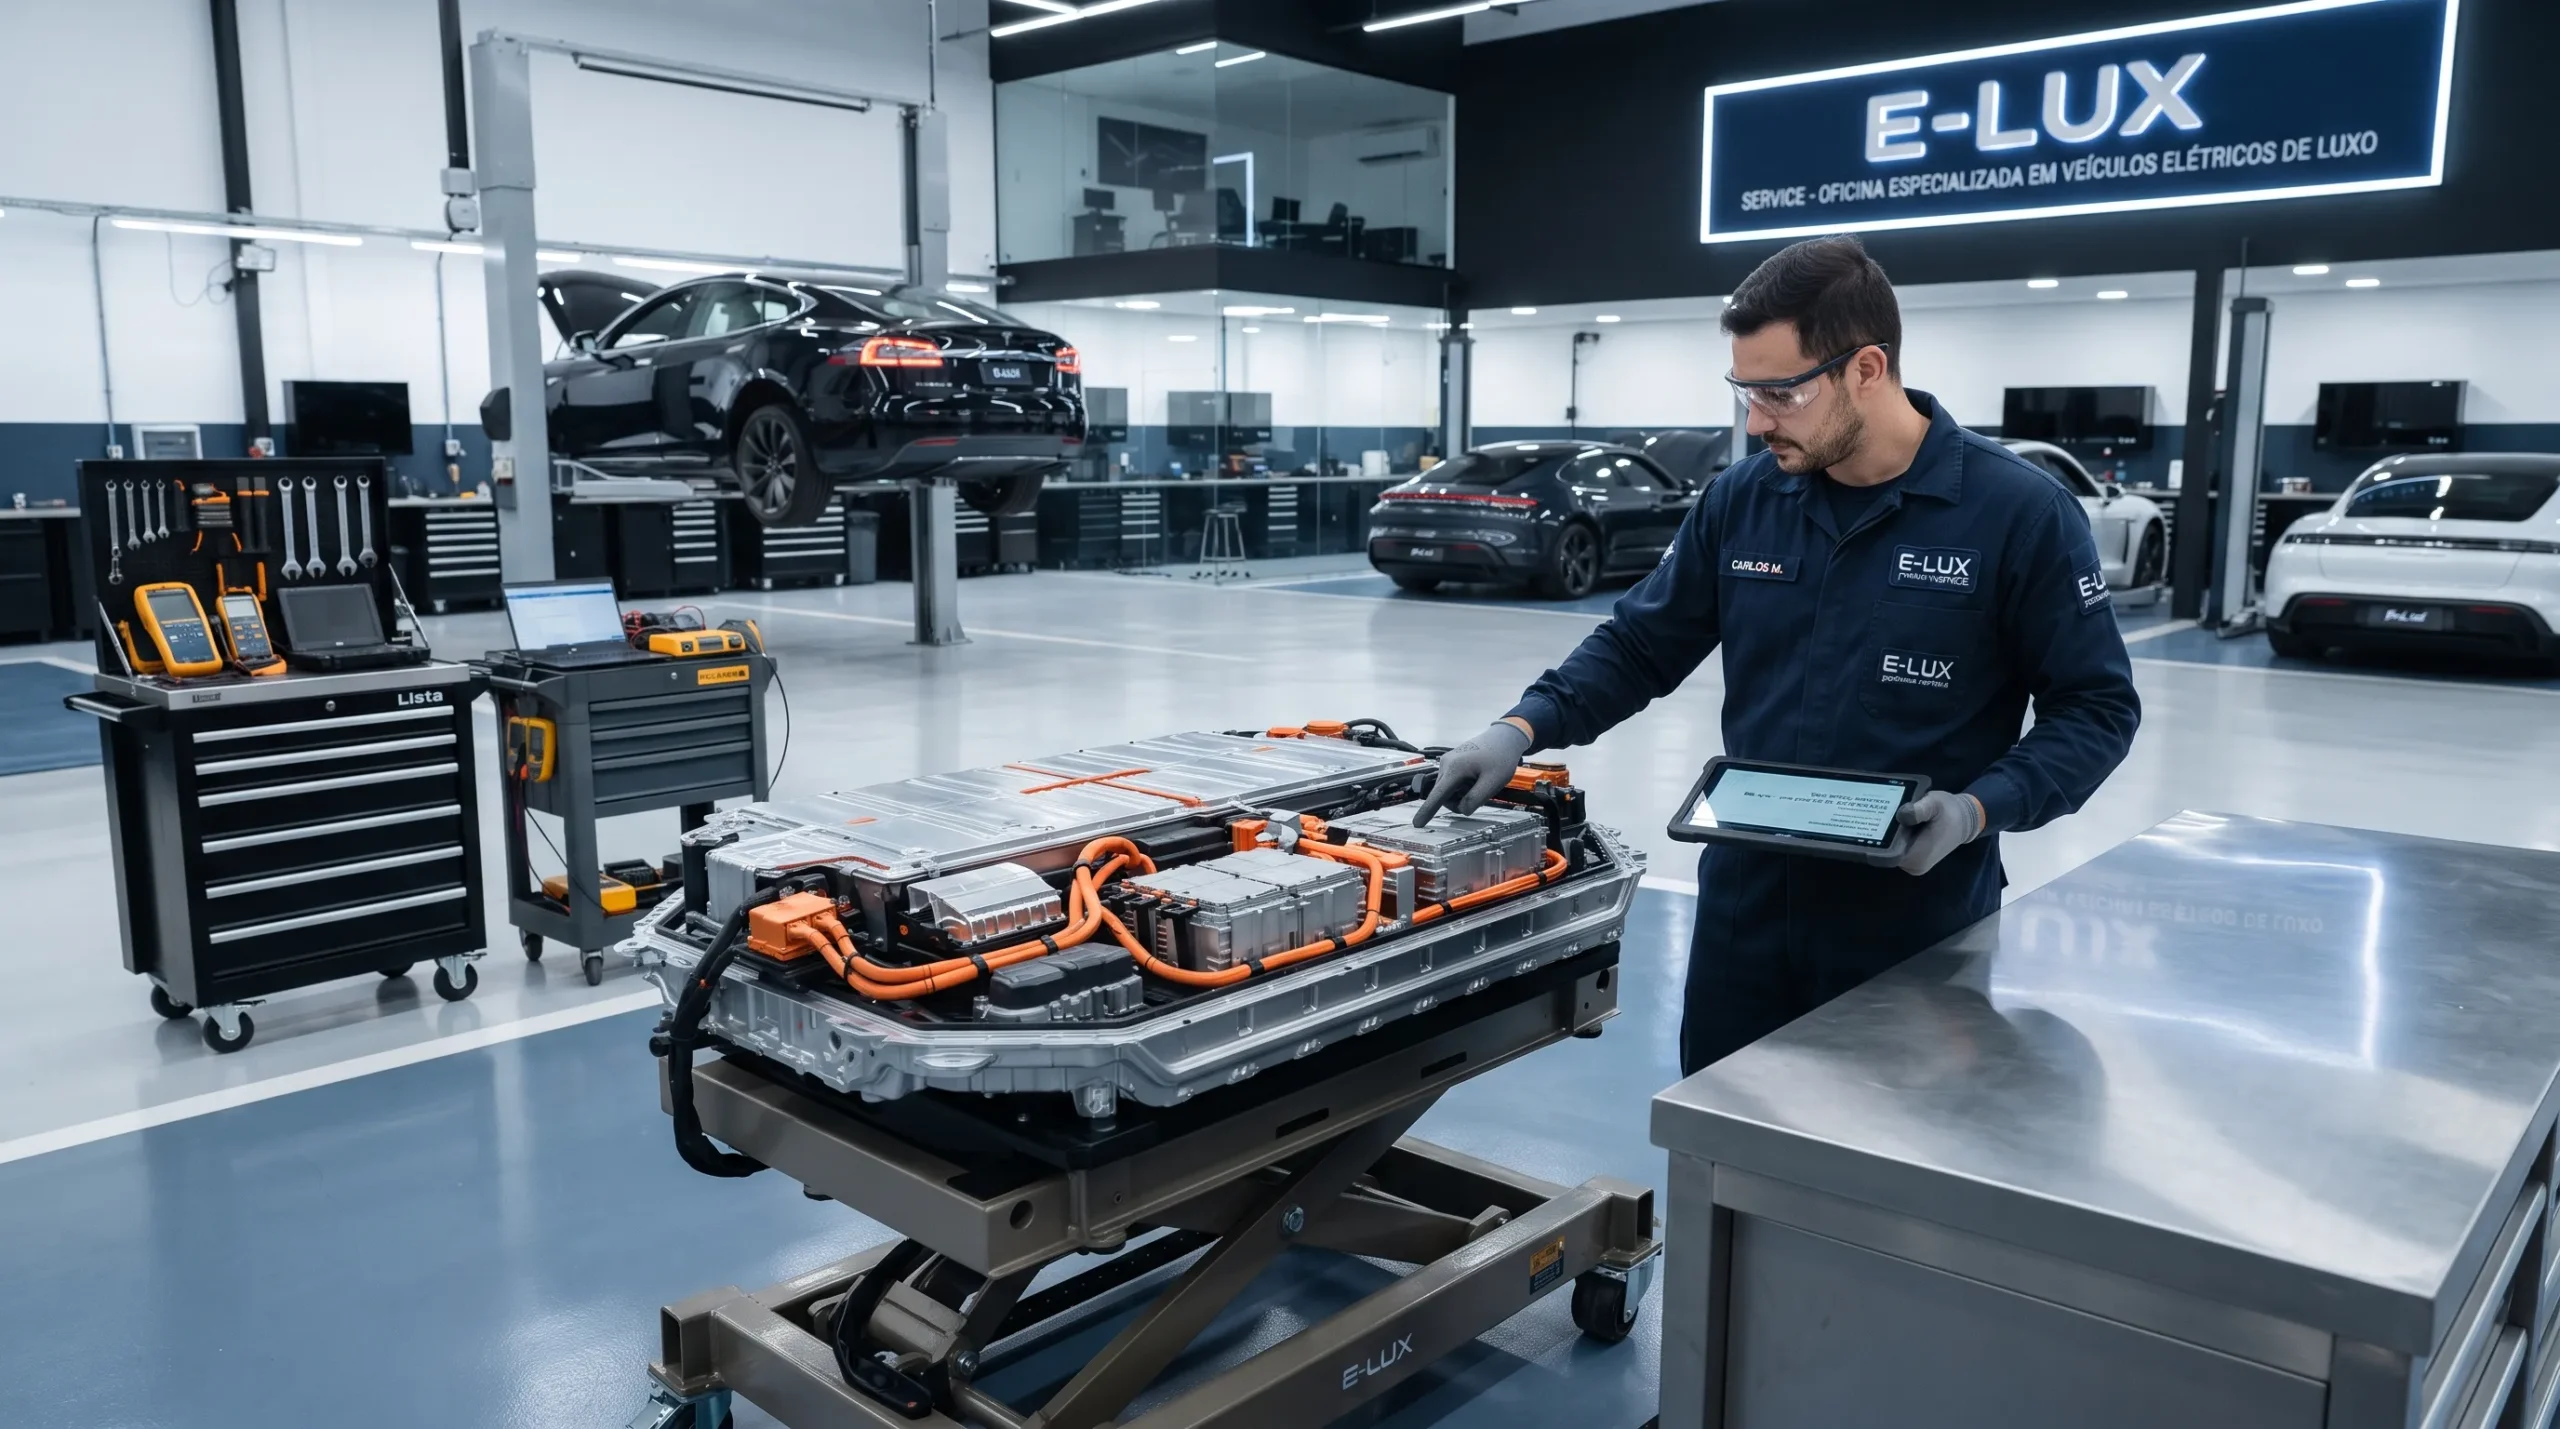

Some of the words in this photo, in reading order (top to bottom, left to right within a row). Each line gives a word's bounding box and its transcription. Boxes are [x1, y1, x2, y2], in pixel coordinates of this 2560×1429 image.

[1865, 53, 2206, 162] E-LUX
[1741, 186, 1806, 211] SERVICE
[1818, 179, 1885, 204] OFICINA
[1888, 167, 2024, 198] ESPECIALIZADA
[2028, 162, 2058, 185] EM
[2062, 152, 2158, 180] VEÍCULOS
[2162, 142, 2278, 174] ELÉTRICOS
[2281, 137, 2313, 162] DE
[2316, 130, 2379, 159] LUXO
[1731, 560, 1769, 572] CARLOS
[1771, 563, 1783, 574] M.
[1898, 553, 1971, 576] E-LUX
[1882, 655, 1954, 680] E-LUX
[1343, 1332, 1413, 1391] E-LUX
